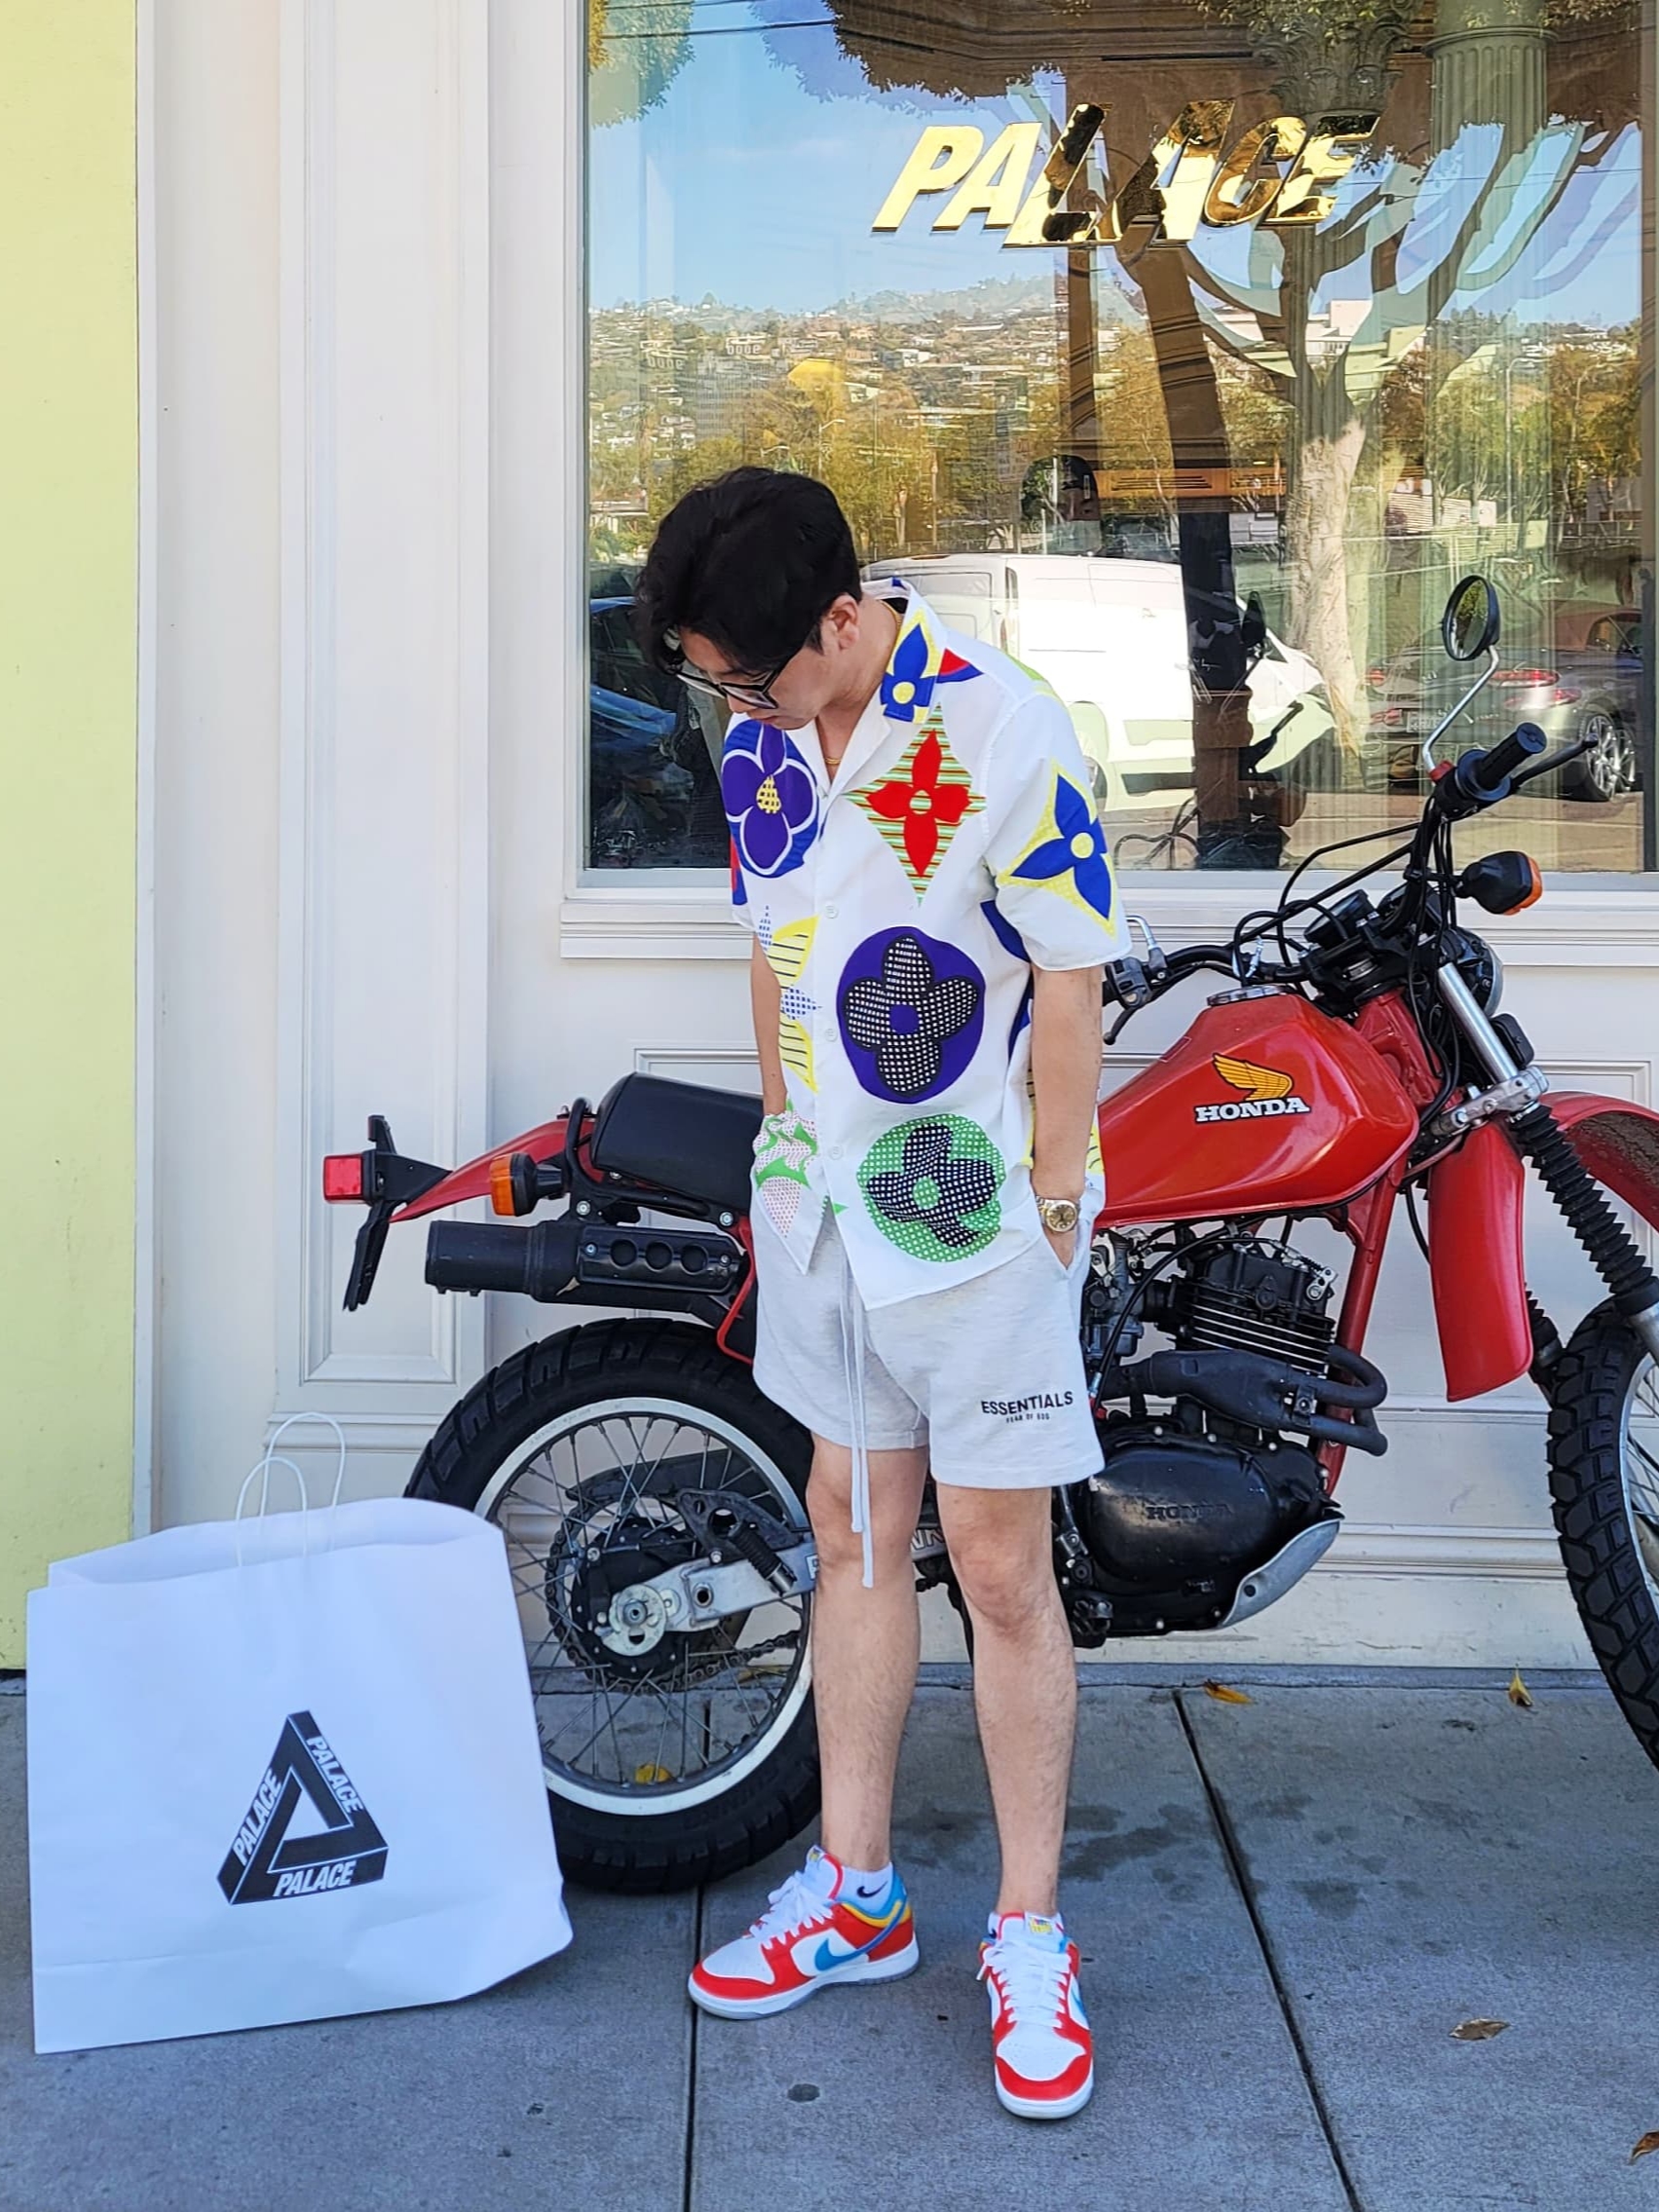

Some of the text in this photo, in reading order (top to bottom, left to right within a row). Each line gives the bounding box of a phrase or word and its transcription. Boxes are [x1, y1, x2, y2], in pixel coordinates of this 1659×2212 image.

[872, 100, 1380, 247] PALACE
[1195, 1097, 1310, 1122] HONDA
[981, 1391, 1074, 1415] ESSENTIALS
[307, 1736, 363, 1814] PALACE
[233, 1769, 282, 1866] PALACE
[273, 1859, 357, 1897] PALACE
